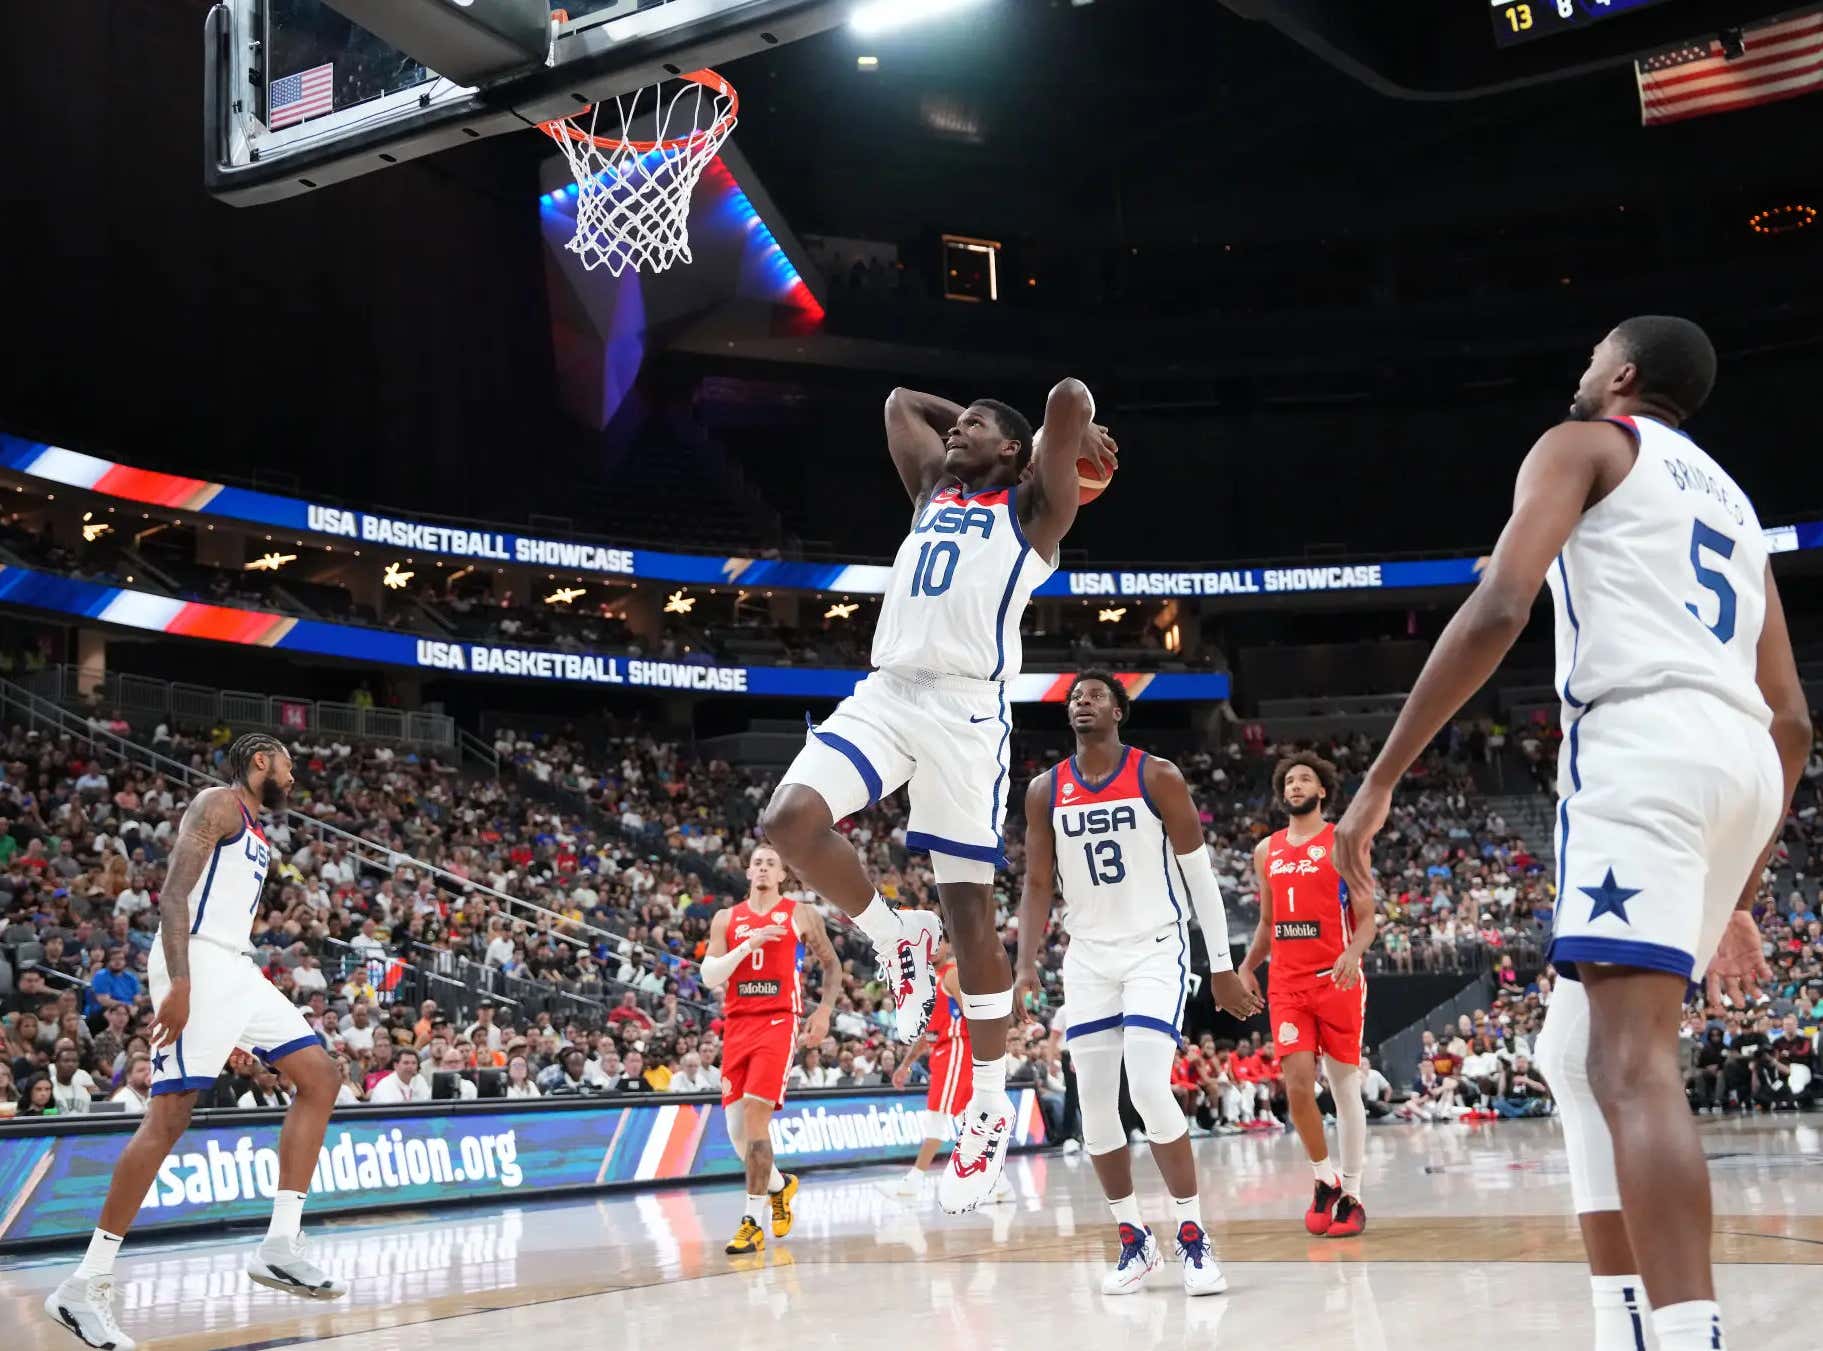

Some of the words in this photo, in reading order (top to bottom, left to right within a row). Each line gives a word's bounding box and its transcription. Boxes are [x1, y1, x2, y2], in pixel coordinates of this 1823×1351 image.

[1505, 4, 1533, 32] 13
[307, 505, 357, 538] USA
[362, 514, 511, 560] BASKETBALL
[514, 537, 635, 575] SHOWCASE
[914, 506, 996, 540] USA
[910, 540, 961, 597] 10
[1069, 571, 1117, 595] USA
[1120, 570, 1260, 595] BASKETBALL
[1263, 564, 1383, 590] SHOWCASE
[1684, 517, 1737, 645] 5
[416, 638, 466, 670] USA
[470, 645, 624, 683] BASKETBALL
[627, 660, 749, 692] SHOWCASE
[1061, 805, 1137, 838] USA
[245, 835, 271, 869] US
[1083, 839, 1126, 887] 13
[250, 871, 264, 915] 7
[1287, 887, 1295, 913] 1
[1283, 924, 1318, 937] Mobile
[752, 948, 764, 971] 0
[140, 1128, 522, 1209] sabfondation.org
